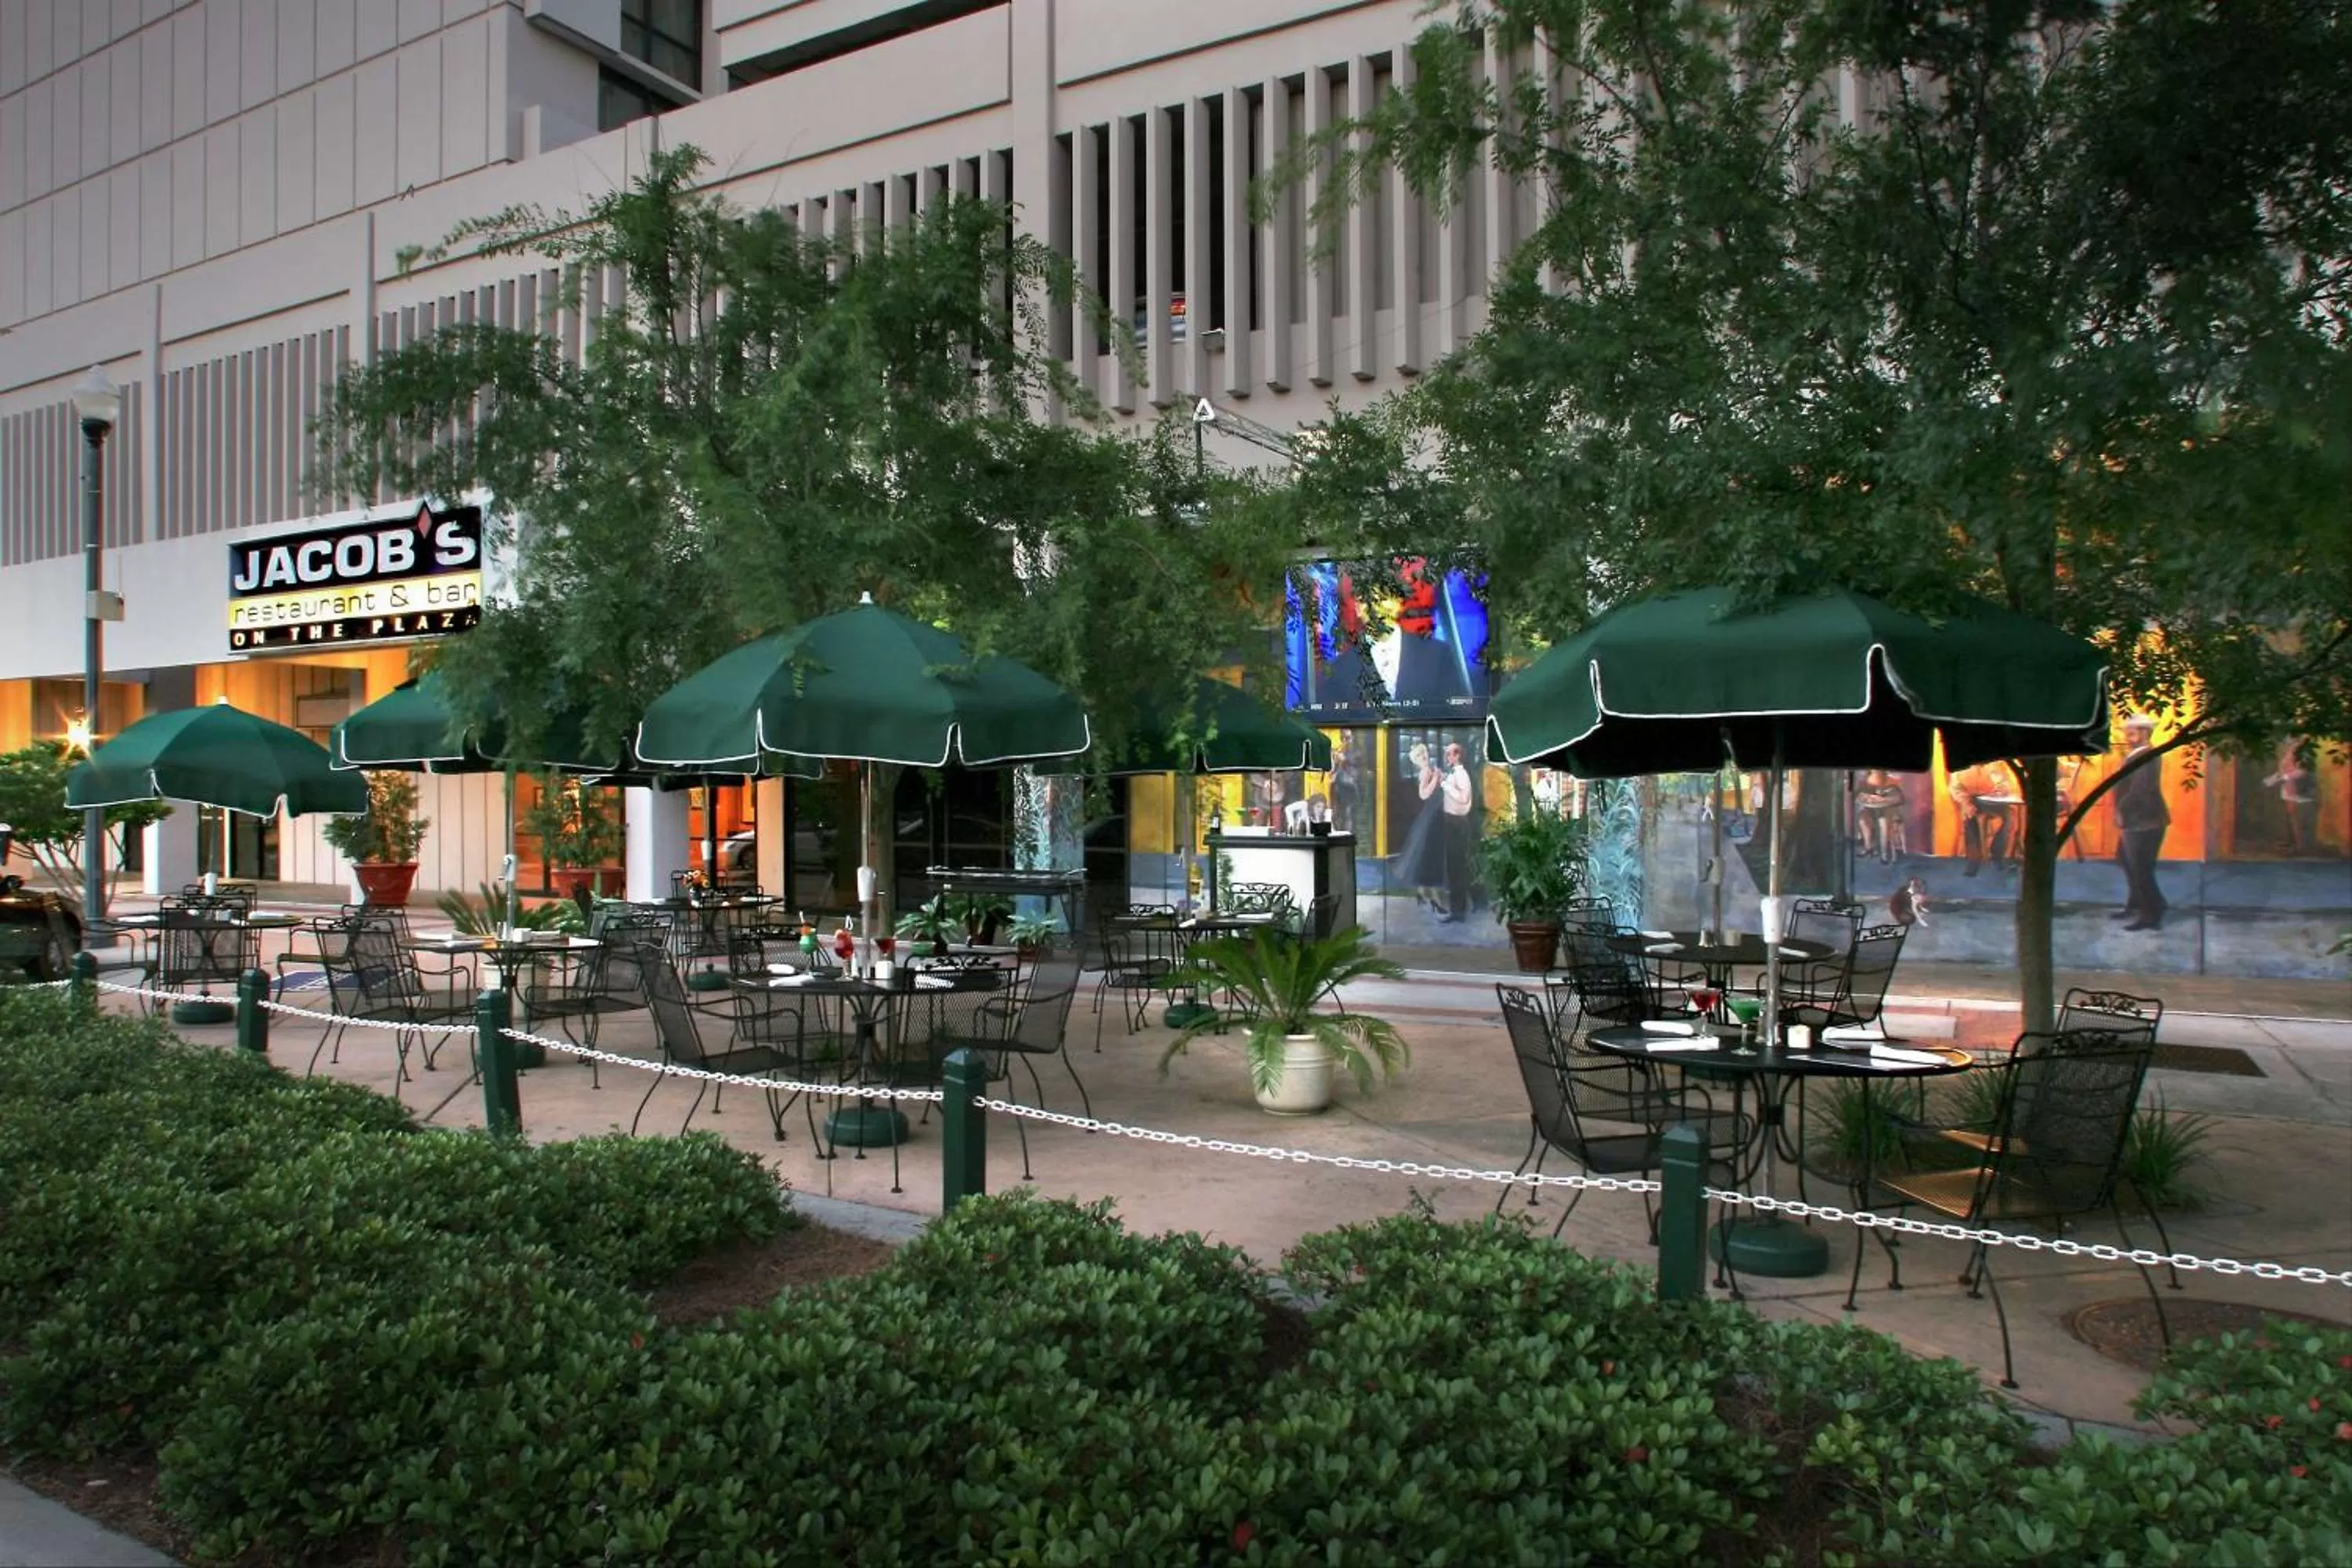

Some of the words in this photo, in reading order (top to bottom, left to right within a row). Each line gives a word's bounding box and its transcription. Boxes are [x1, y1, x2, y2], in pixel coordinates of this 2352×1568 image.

[234, 510, 476, 590] JACOB'S
[235, 591, 376, 622] restaurant
[390, 584, 409, 608] &
[427, 581, 476, 604] bar
[234, 630, 264, 646] ON
[291, 623, 343, 641] THE
